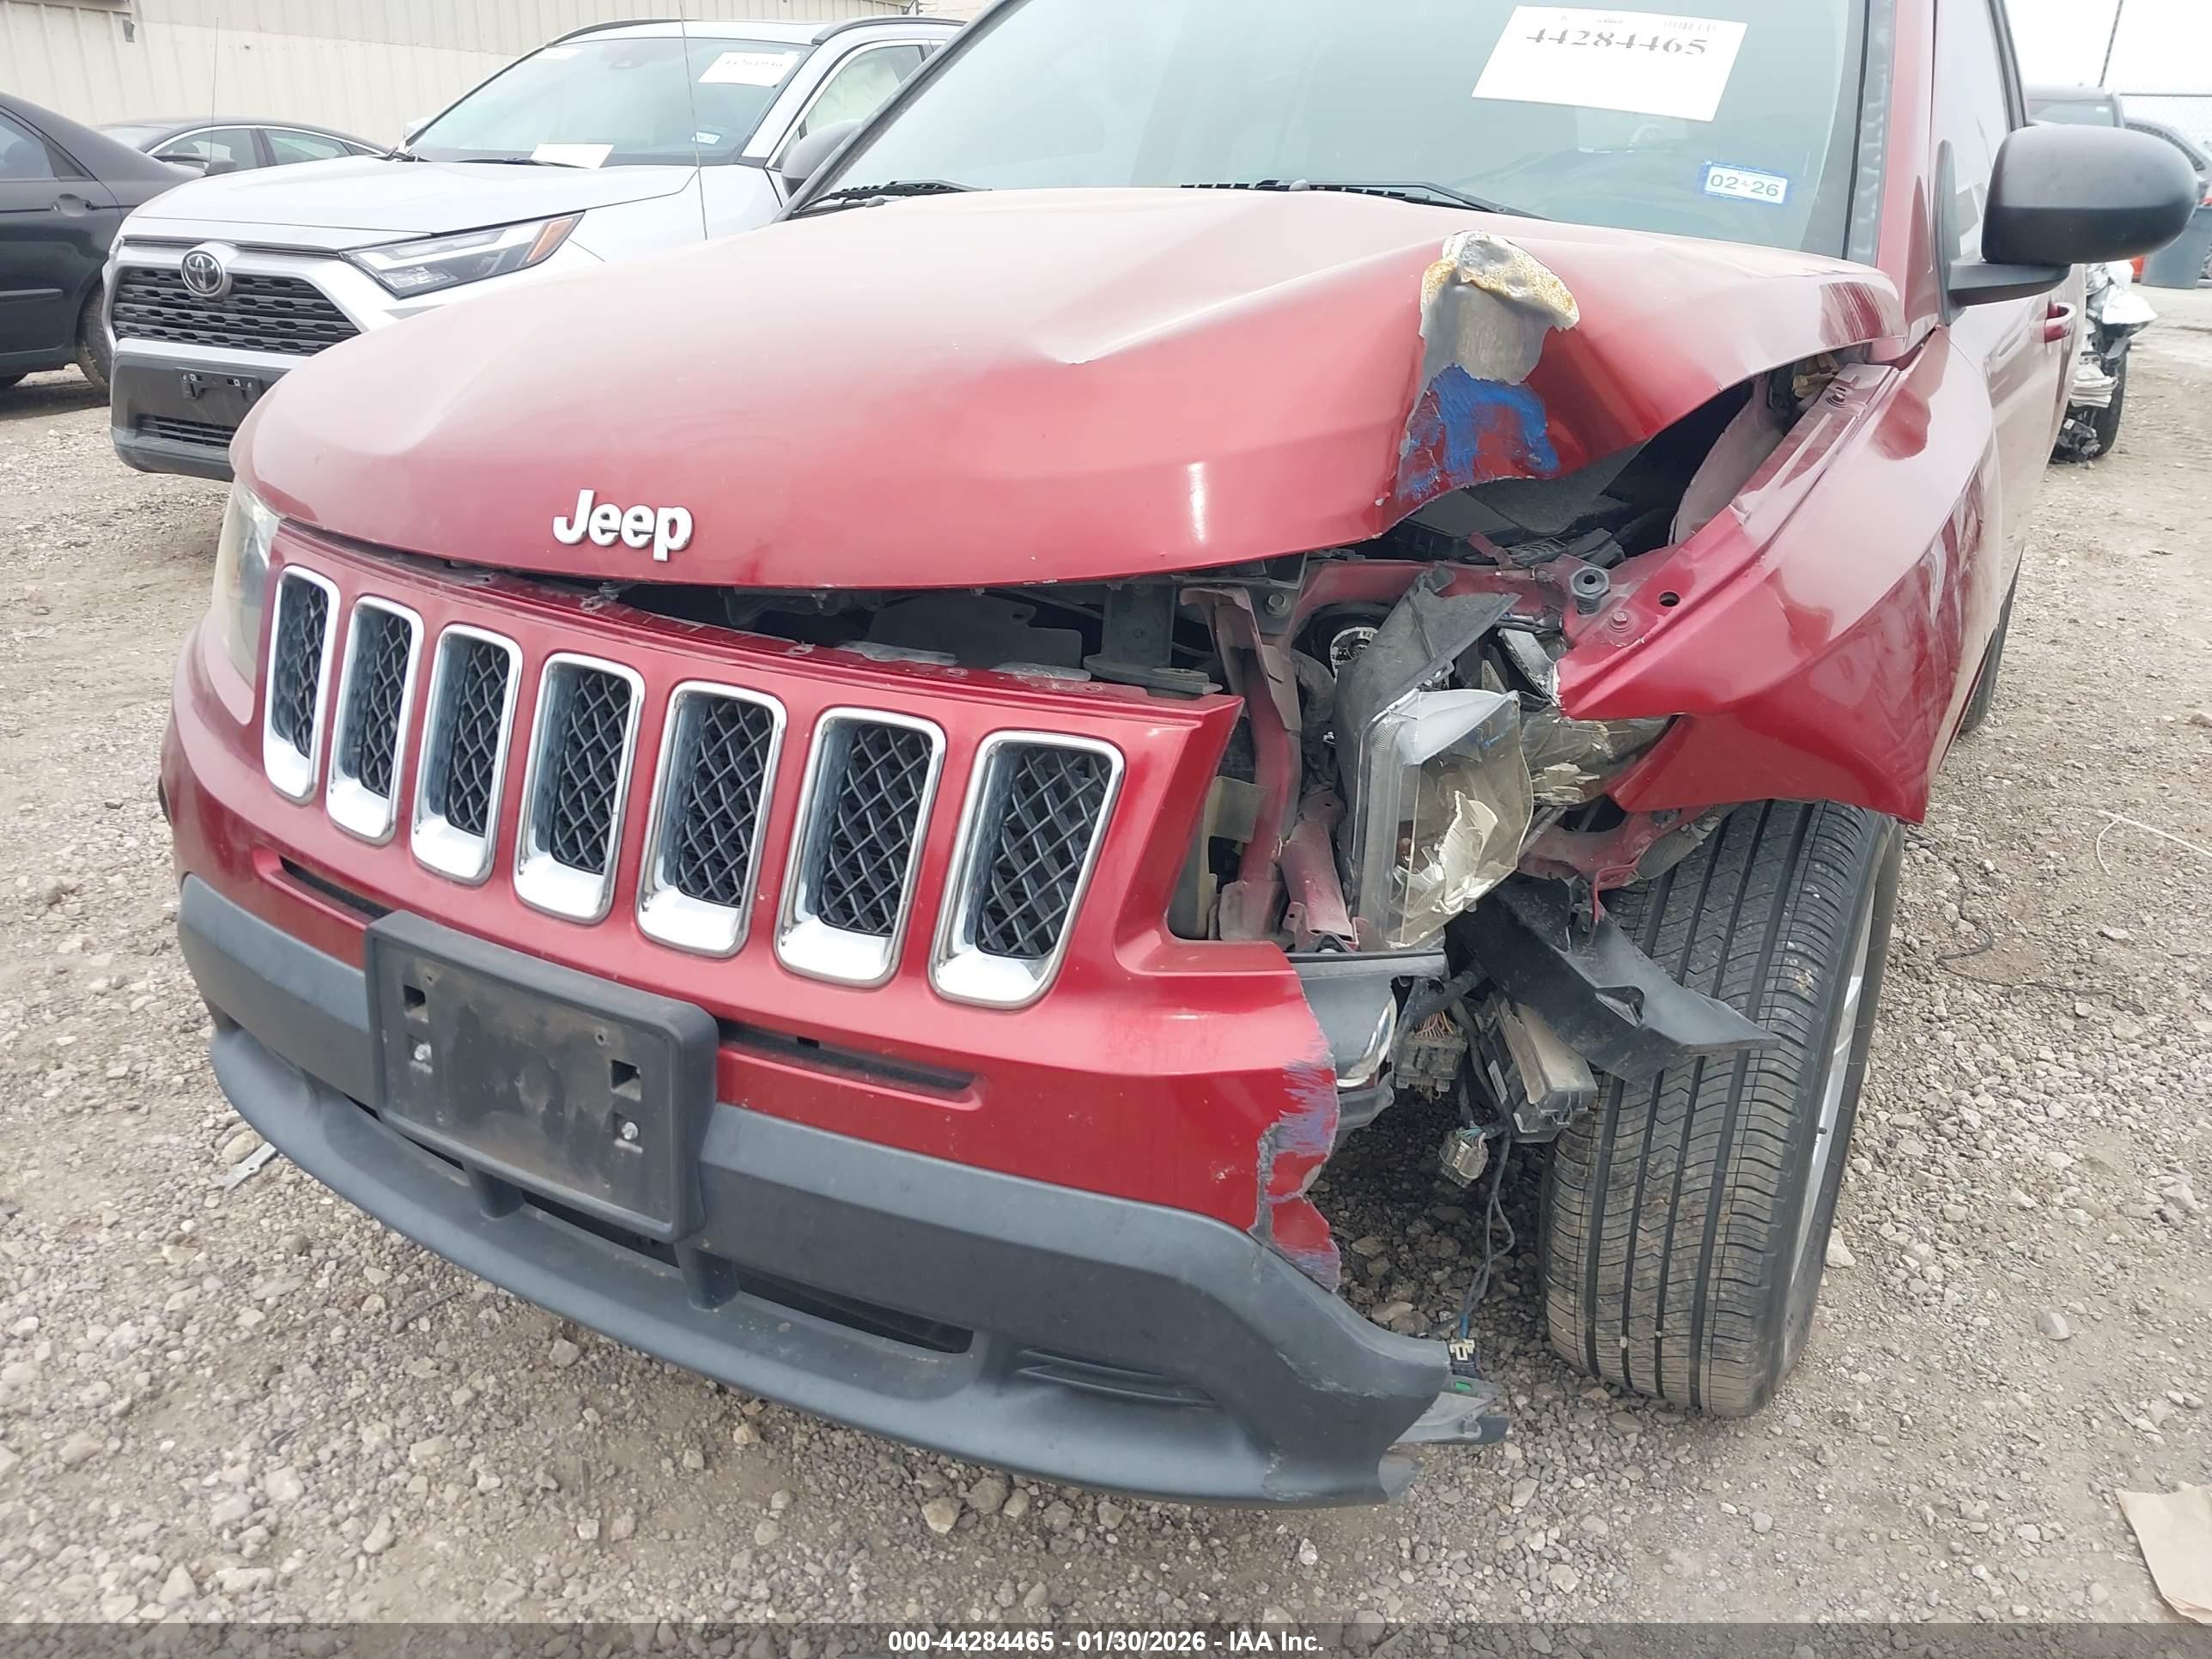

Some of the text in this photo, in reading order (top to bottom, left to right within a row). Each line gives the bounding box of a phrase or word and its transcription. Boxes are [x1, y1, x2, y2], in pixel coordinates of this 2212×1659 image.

[1526, 27, 1709, 55] 44284465
[1710, 173, 1739, 190] 02
[1750, 180, 1779, 197] 26
[551, 488, 694, 562] Jeep
